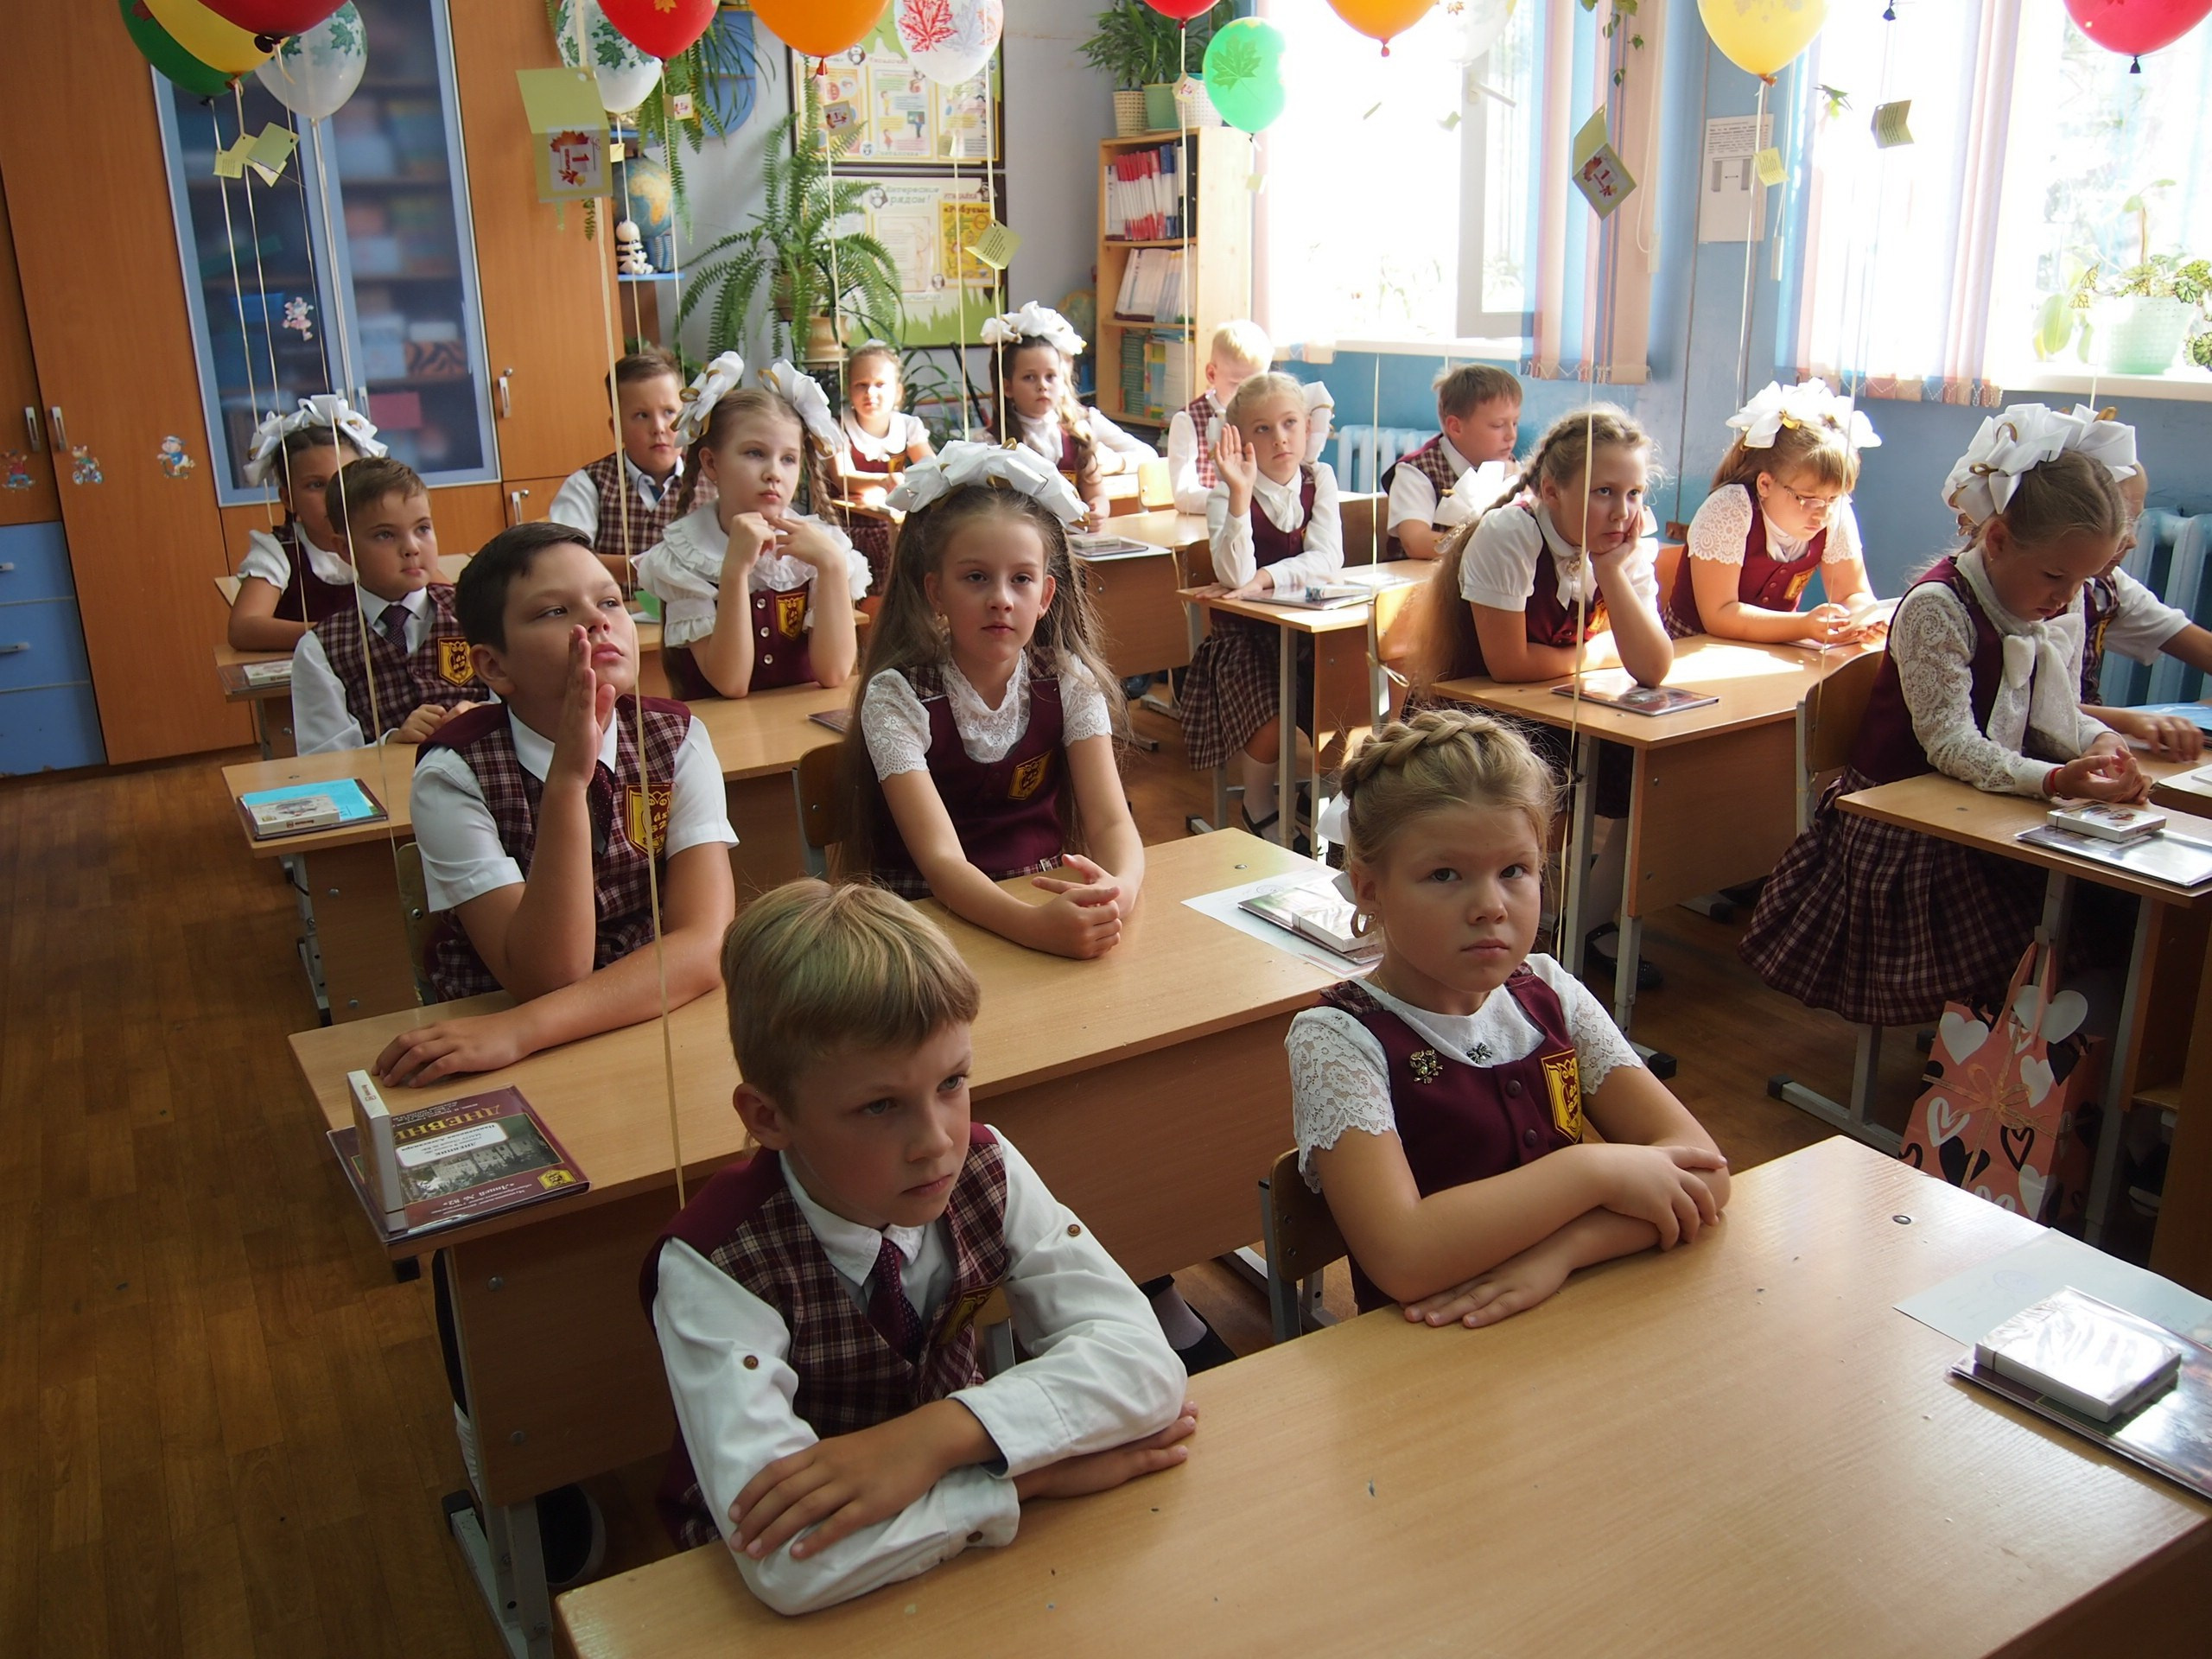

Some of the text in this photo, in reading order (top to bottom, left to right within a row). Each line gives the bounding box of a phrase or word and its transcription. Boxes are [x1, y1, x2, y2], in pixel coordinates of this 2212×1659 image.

[571, 153, 590, 162] 1
[944, 203, 989, 214] «Рбусы»
[394, 1104, 500, 1141] ДНЕВНИ
